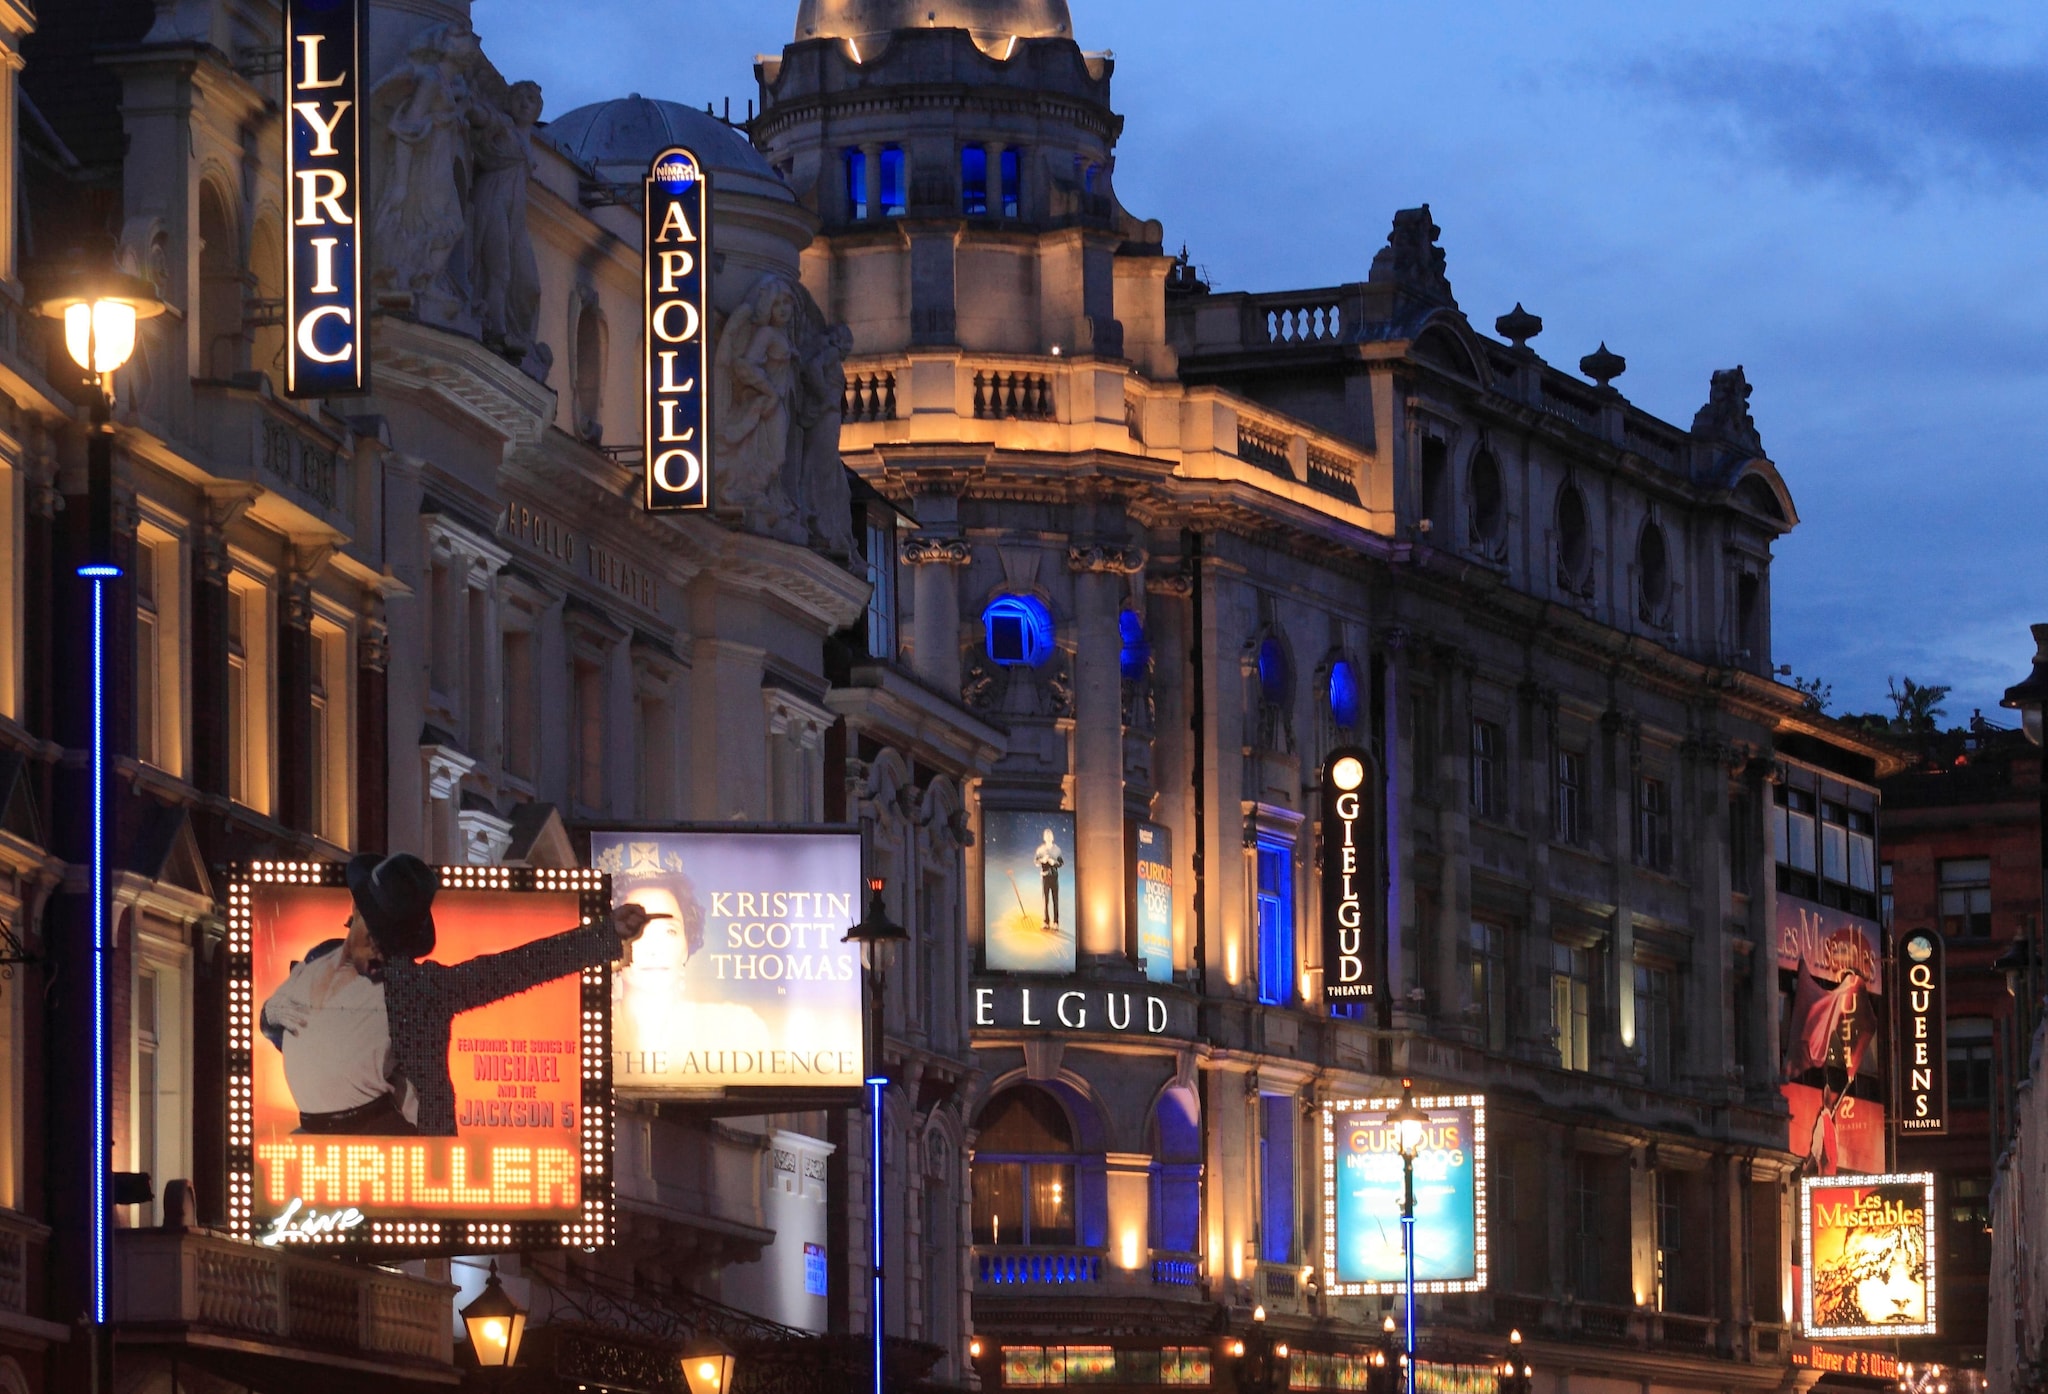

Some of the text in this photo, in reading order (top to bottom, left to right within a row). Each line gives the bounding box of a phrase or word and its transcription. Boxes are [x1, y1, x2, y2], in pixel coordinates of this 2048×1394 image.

[293, 34, 353, 363] LYRIC
[652, 201, 700, 493] APOLLO
[508, 502, 574, 564] APOLLO
[1137, 860, 1172, 885] CURIOUS
[1336, 793, 1363, 982] GIELGUD
[710, 892, 851, 919] KRISTIN
[728, 923, 834, 949] SCOTT
[710, 954, 853, 981] THOMAS
[1327, 985, 1373, 996] THEATRE
[457, 1039, 576, 1054] FEATURING THE SONGS OF
[1909, 964, 1935, 1117] QUEENS
[474, 1055, 560, 1082] MICHAEL
[682, 1051, 854, 1075] AUDIENCE
[498, 1085, 537, 1098] AND THE
[460, 1100, 575, 1128] JACKSON 5
[1903, 1119, 1941, 1129] THEATRE
[258, 1143, 576, 1205] THRILLER
[1853, 1190, 1881, 1209] Les
[263, 1197, 364, 1246] Live
[1815, 1200, 1923, 1228] Misérables
[1846, 1352, 1858, 1373] of
[1860, 1352, 1868, 1375] 3
